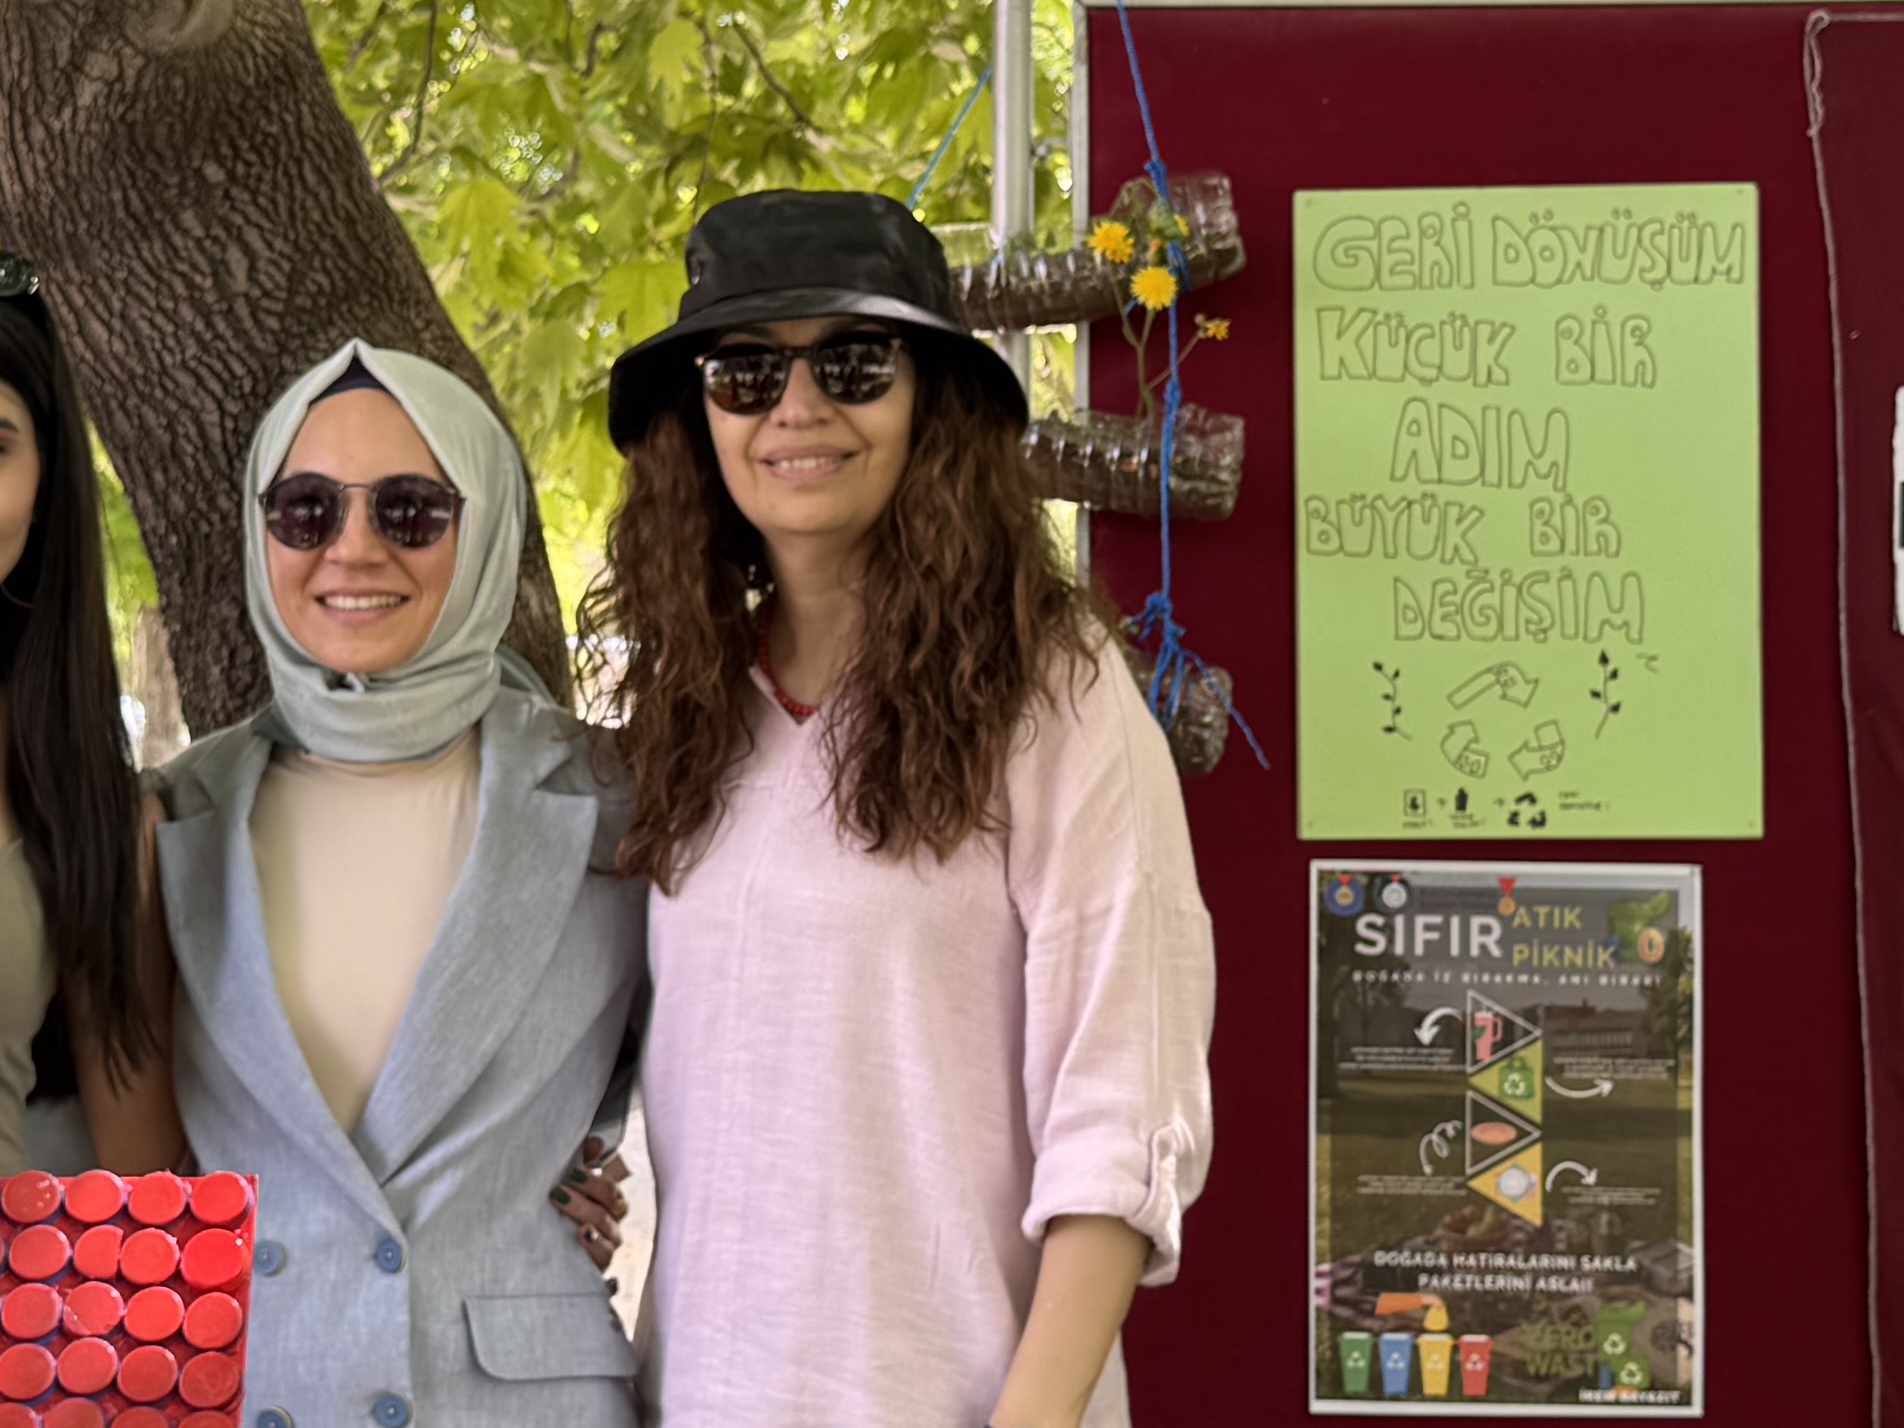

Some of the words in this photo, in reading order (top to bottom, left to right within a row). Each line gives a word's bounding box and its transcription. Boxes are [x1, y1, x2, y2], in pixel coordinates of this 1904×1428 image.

[1313, 203, 1474, 291] GERİ
[1492, 207, 1745, 291] DÖNÜŞÜM
[1315, 305, 1515, 387] KÜÇÜK
[1554, 305, 1656, 388] BİR
[1390, 397, 1570, 491] ADIM
[1304, 492, 1484, 567] BÜYÜK
[1529, 489, 1622, 558] BİR
[1394, 565, 1643, 644] DEĞİŞİM
[1354, 913, 1502, 957] SIFIR
[1512, 905, 1583, 929] ATIK
[1512, 938, 1618, 969] PİKNİK
[1374, 1250, 1446, 1268] DOĞADA
[1580, 1255, 1637, 1272] SAKLA
